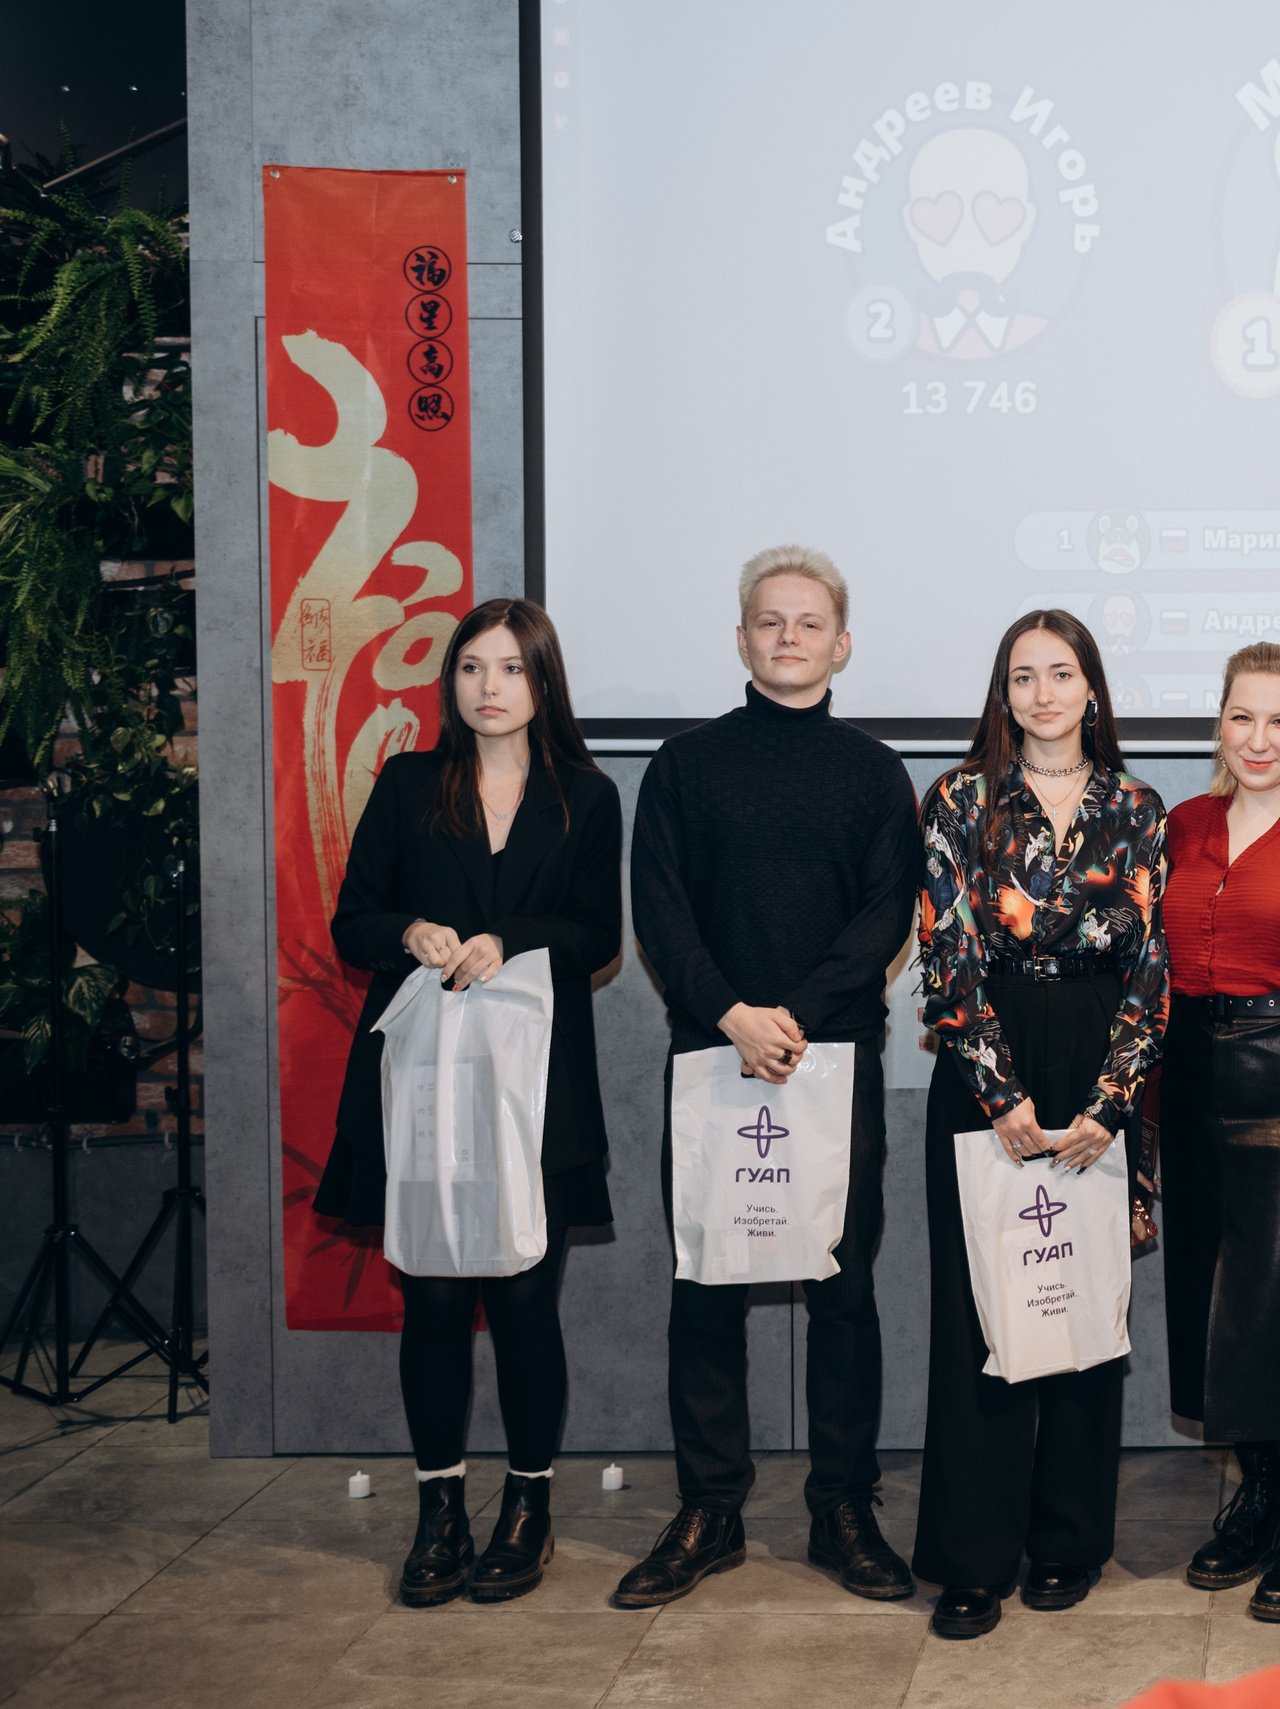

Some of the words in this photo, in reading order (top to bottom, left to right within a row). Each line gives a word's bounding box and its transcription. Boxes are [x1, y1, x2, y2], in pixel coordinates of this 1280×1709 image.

[825, 80, 993, 254] Андреев
[1008, 83, 1100, 254] Игорь
[867, 302, 894, 339] 2
[1244, 319, 1276, 365] 1
[902, 380, 948, 415] 13
[963, 380, 1038, 415] 746
[1058, 529, 1073, 550] 1
[735, 1168, 790, 1183] ГУАП
[746, 1204, 779, 1214] Учись.
[734, 1216, 790, 1226] Изобретай.
[747, 1229, 777, 1238] Живи.
[1023, 1242, 1073, 1266] ГУАП
[1037, 1283, 1067, 1294] Учись.
[1027, 1290, 1078, 1308] Изобретай.
[1041, 1308, 1069, 1318] Живи.
